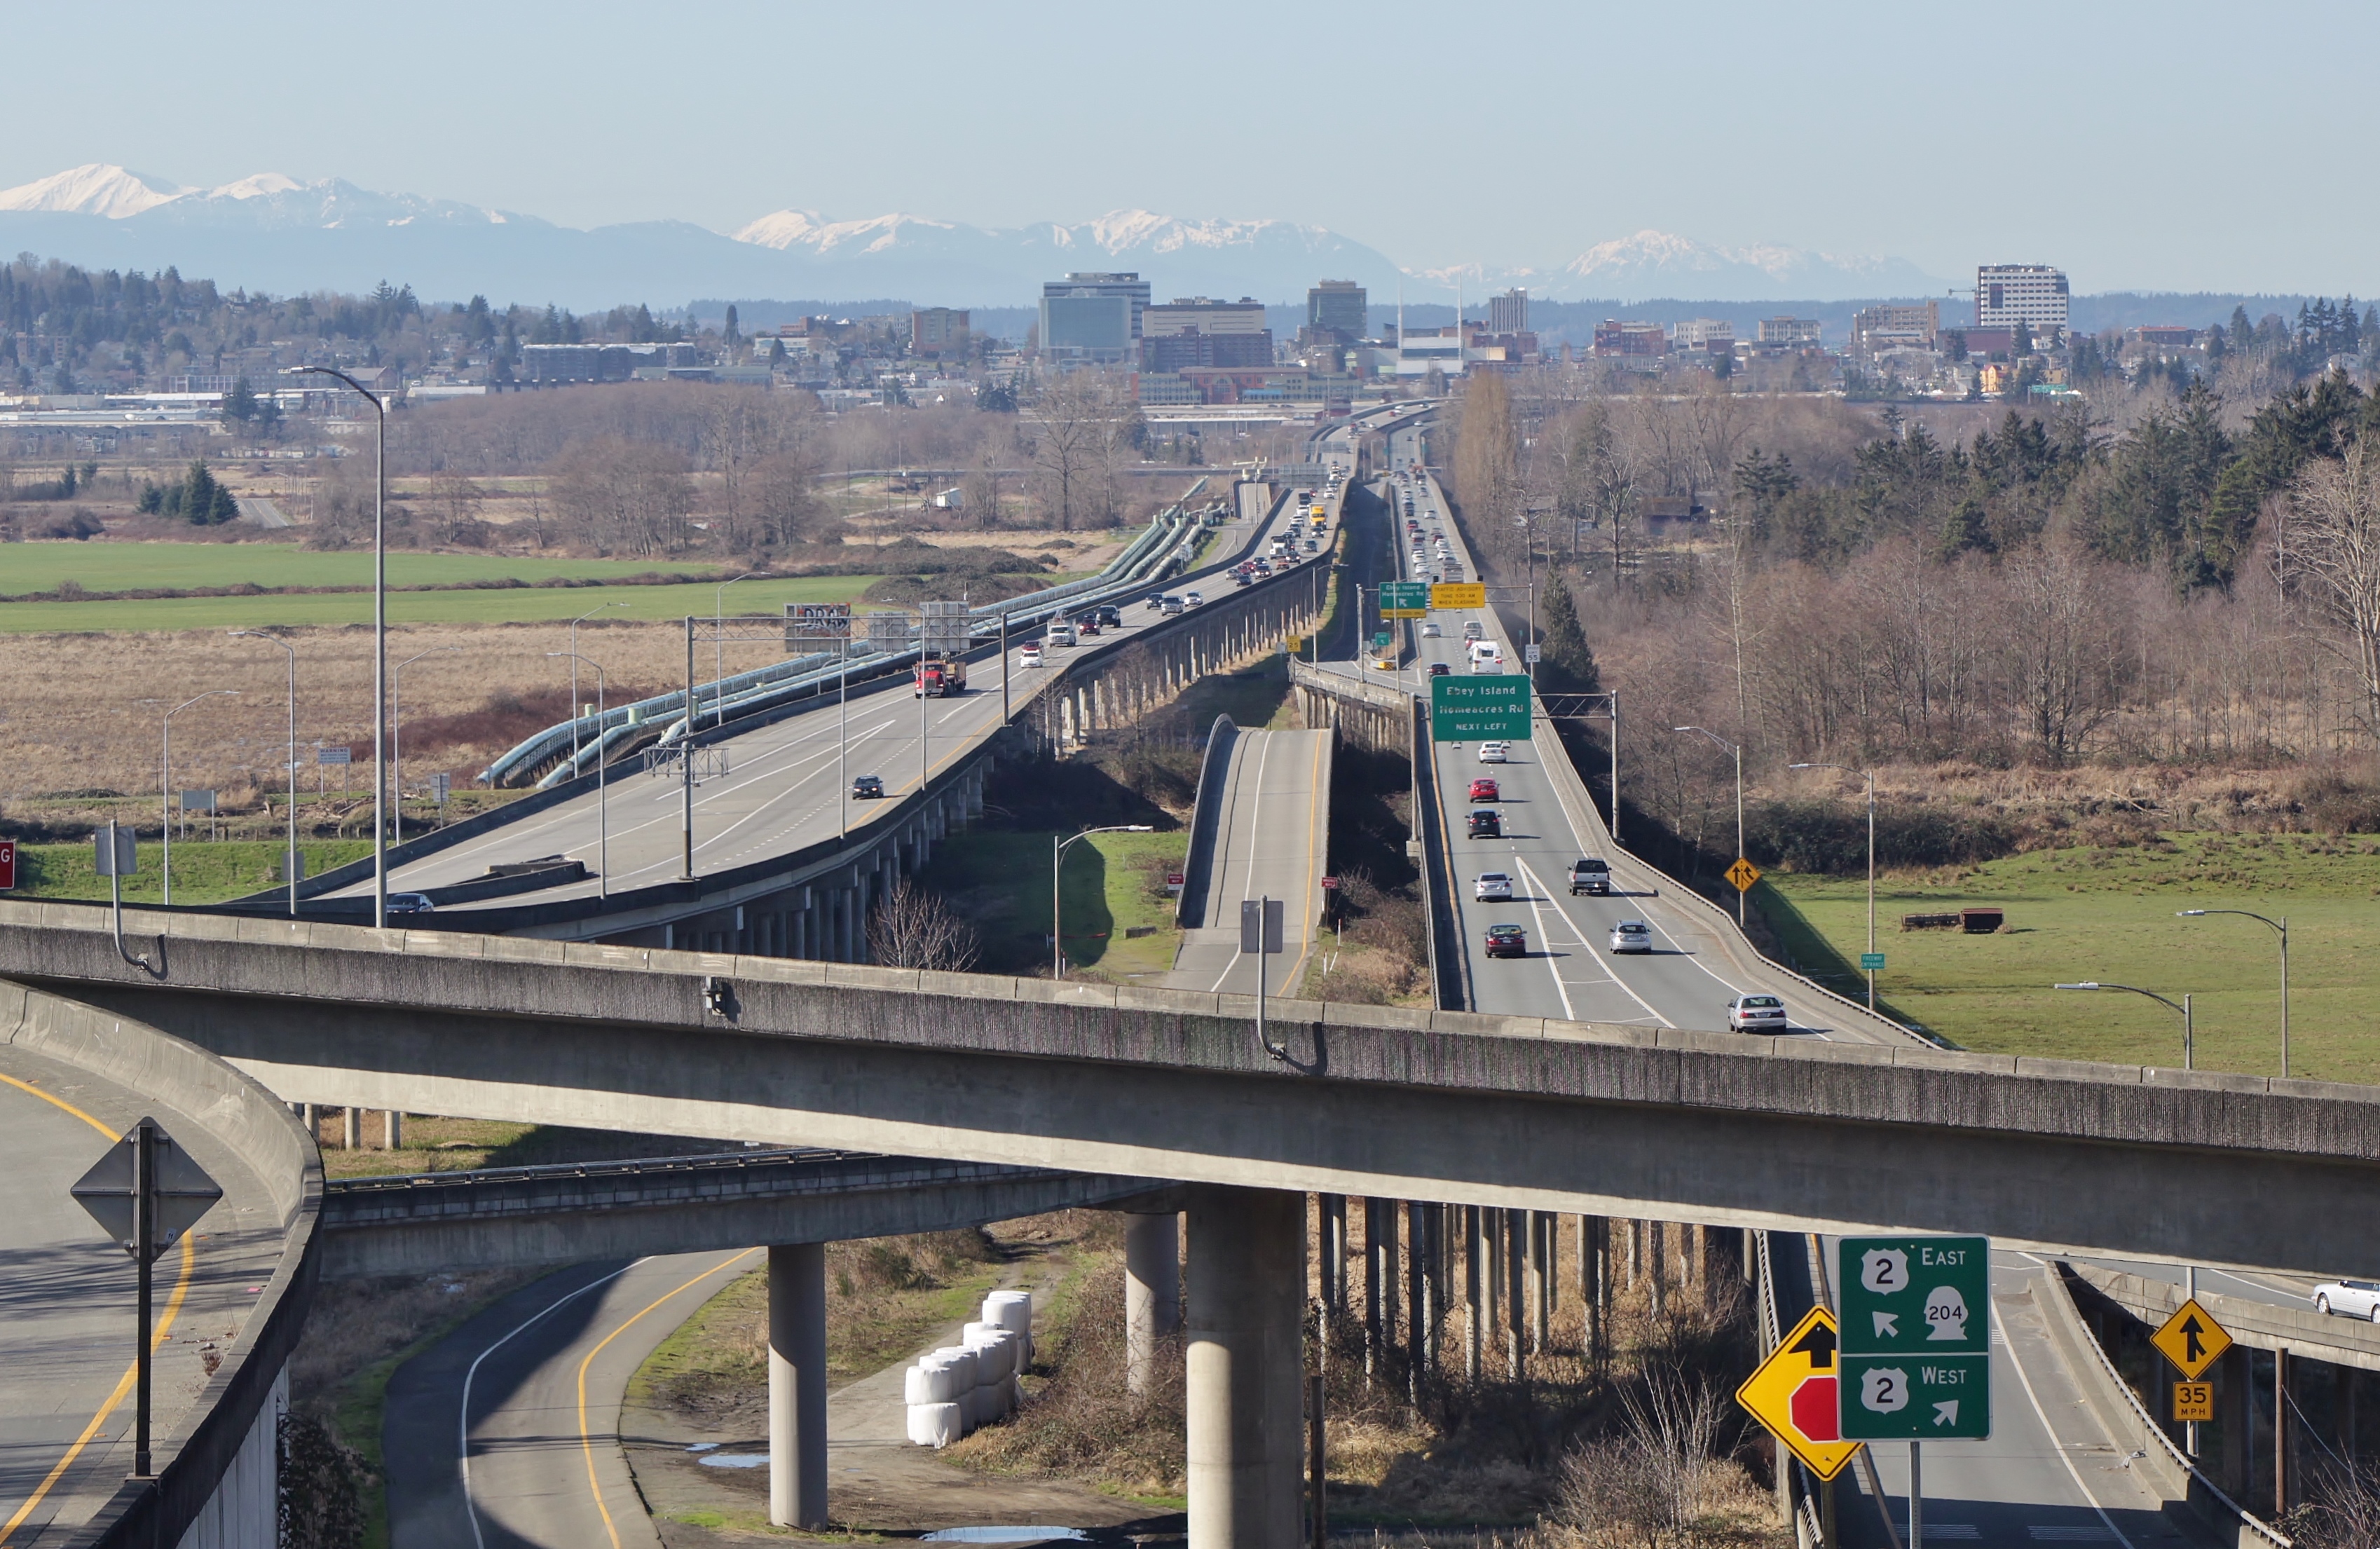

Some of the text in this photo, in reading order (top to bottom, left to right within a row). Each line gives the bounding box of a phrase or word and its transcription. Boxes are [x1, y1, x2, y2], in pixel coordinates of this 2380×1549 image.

[1447, 686, 1516, 697] Ebey Island
[1439, 704, 1524, 714] Homeacres Rd
[1875, 1248, 1966, 1284] 2 EAST
[1929, 1306, 1962, 1321] 204
[1876, 1366, 1967, 1403] 2 WEST
[2179, 1387, 2206, 1404] 35
